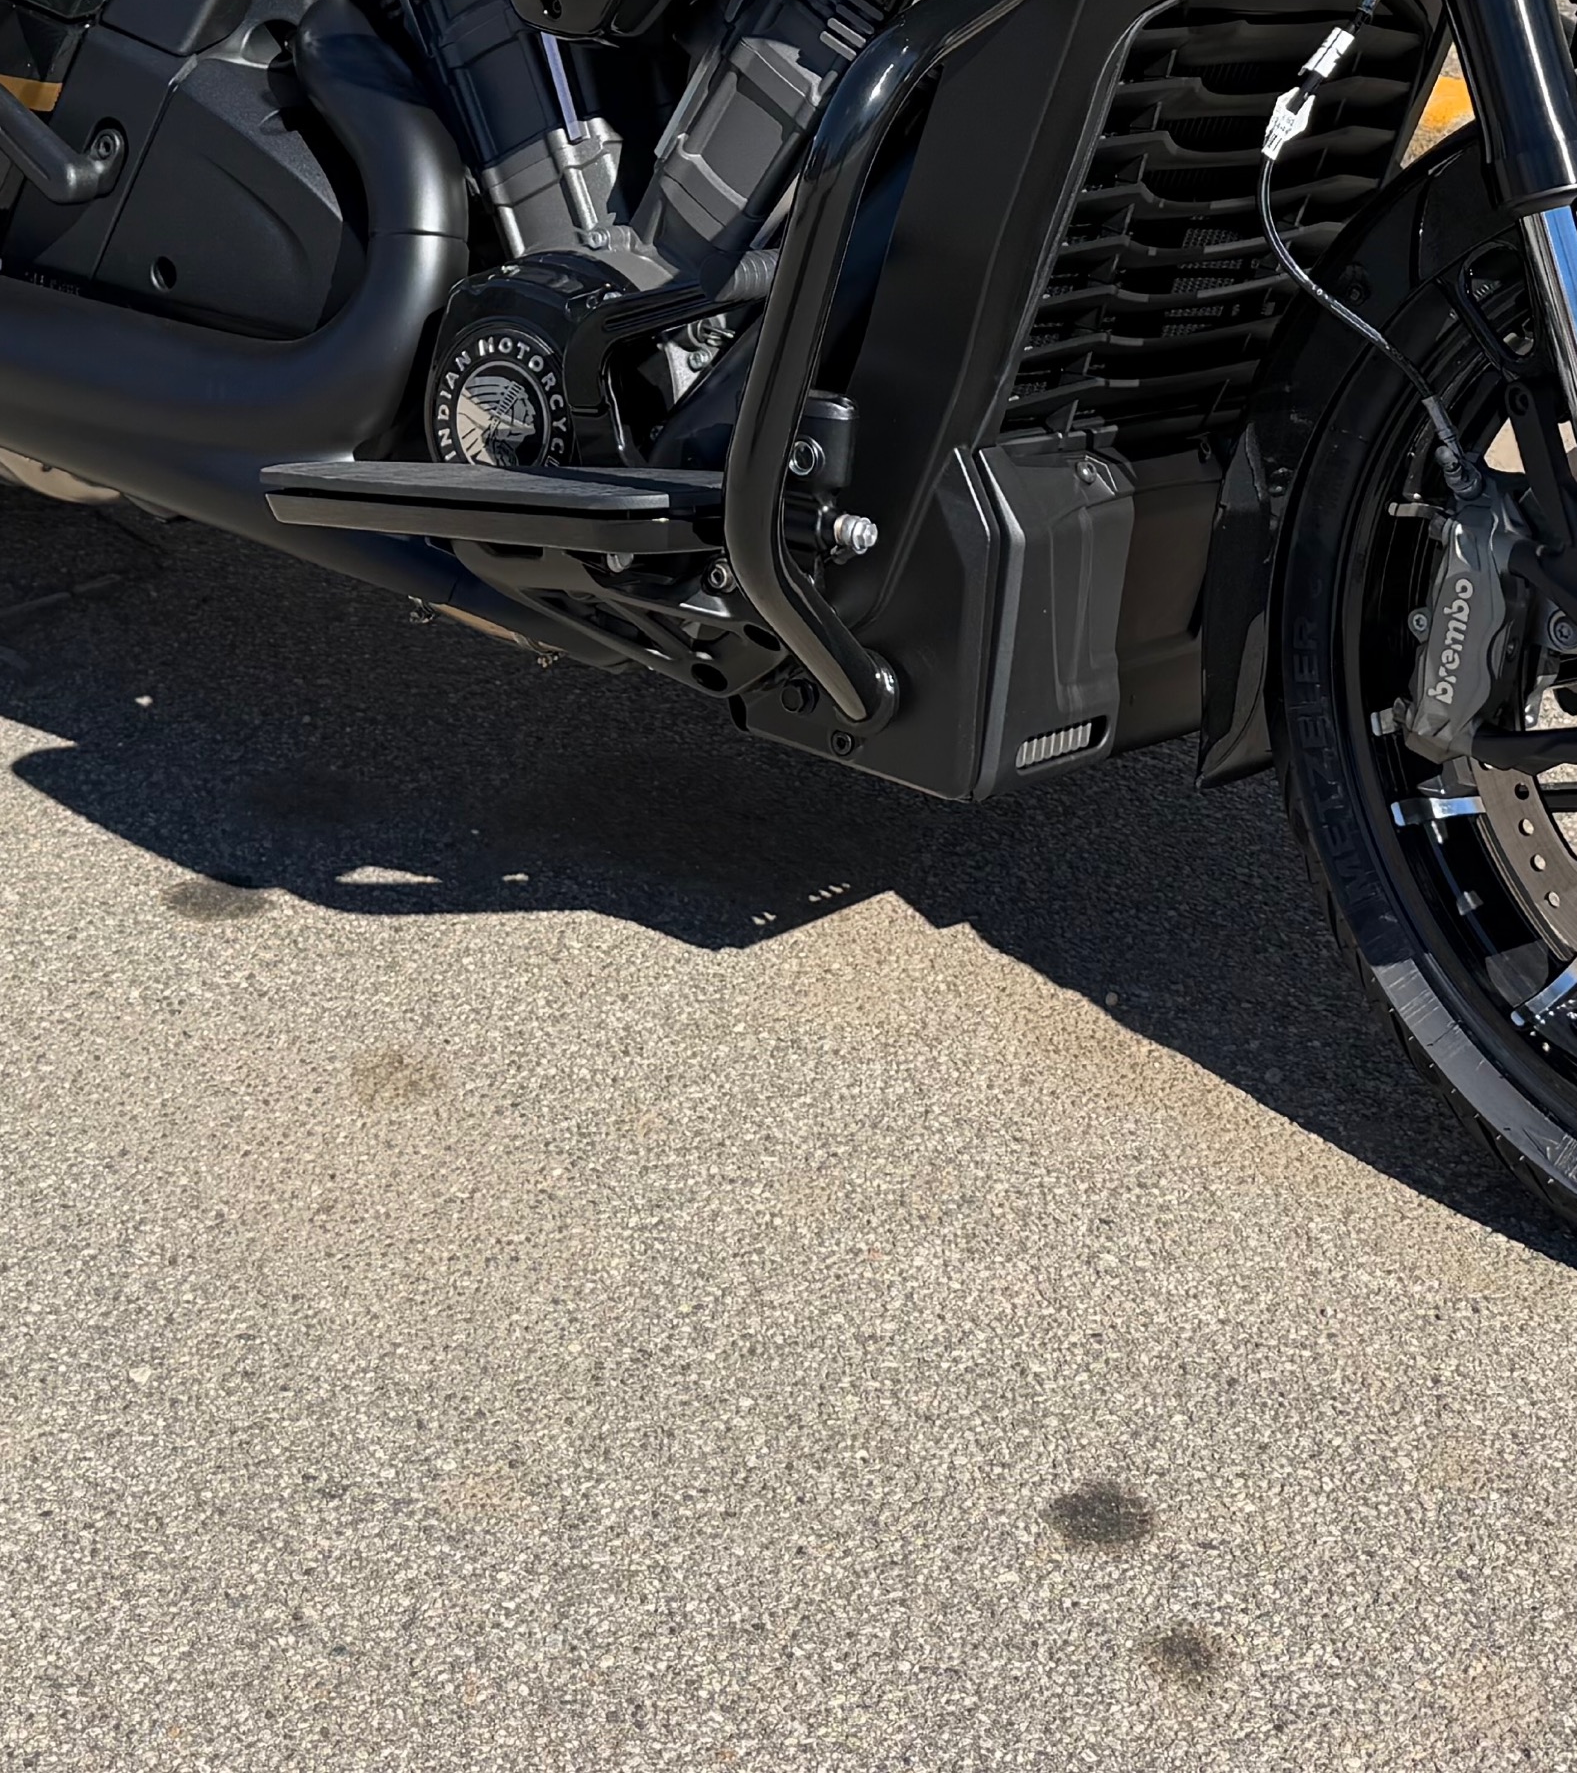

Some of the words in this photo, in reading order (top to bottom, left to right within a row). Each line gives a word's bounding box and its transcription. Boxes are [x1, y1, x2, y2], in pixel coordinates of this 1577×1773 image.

[438, 350, 472, 461] INDIAN
[478, 336, 567, 467] MOTORCYCL
[1428, 578, 1474, 704] brembo
[1293, 616, 1378, 905] METZELER
